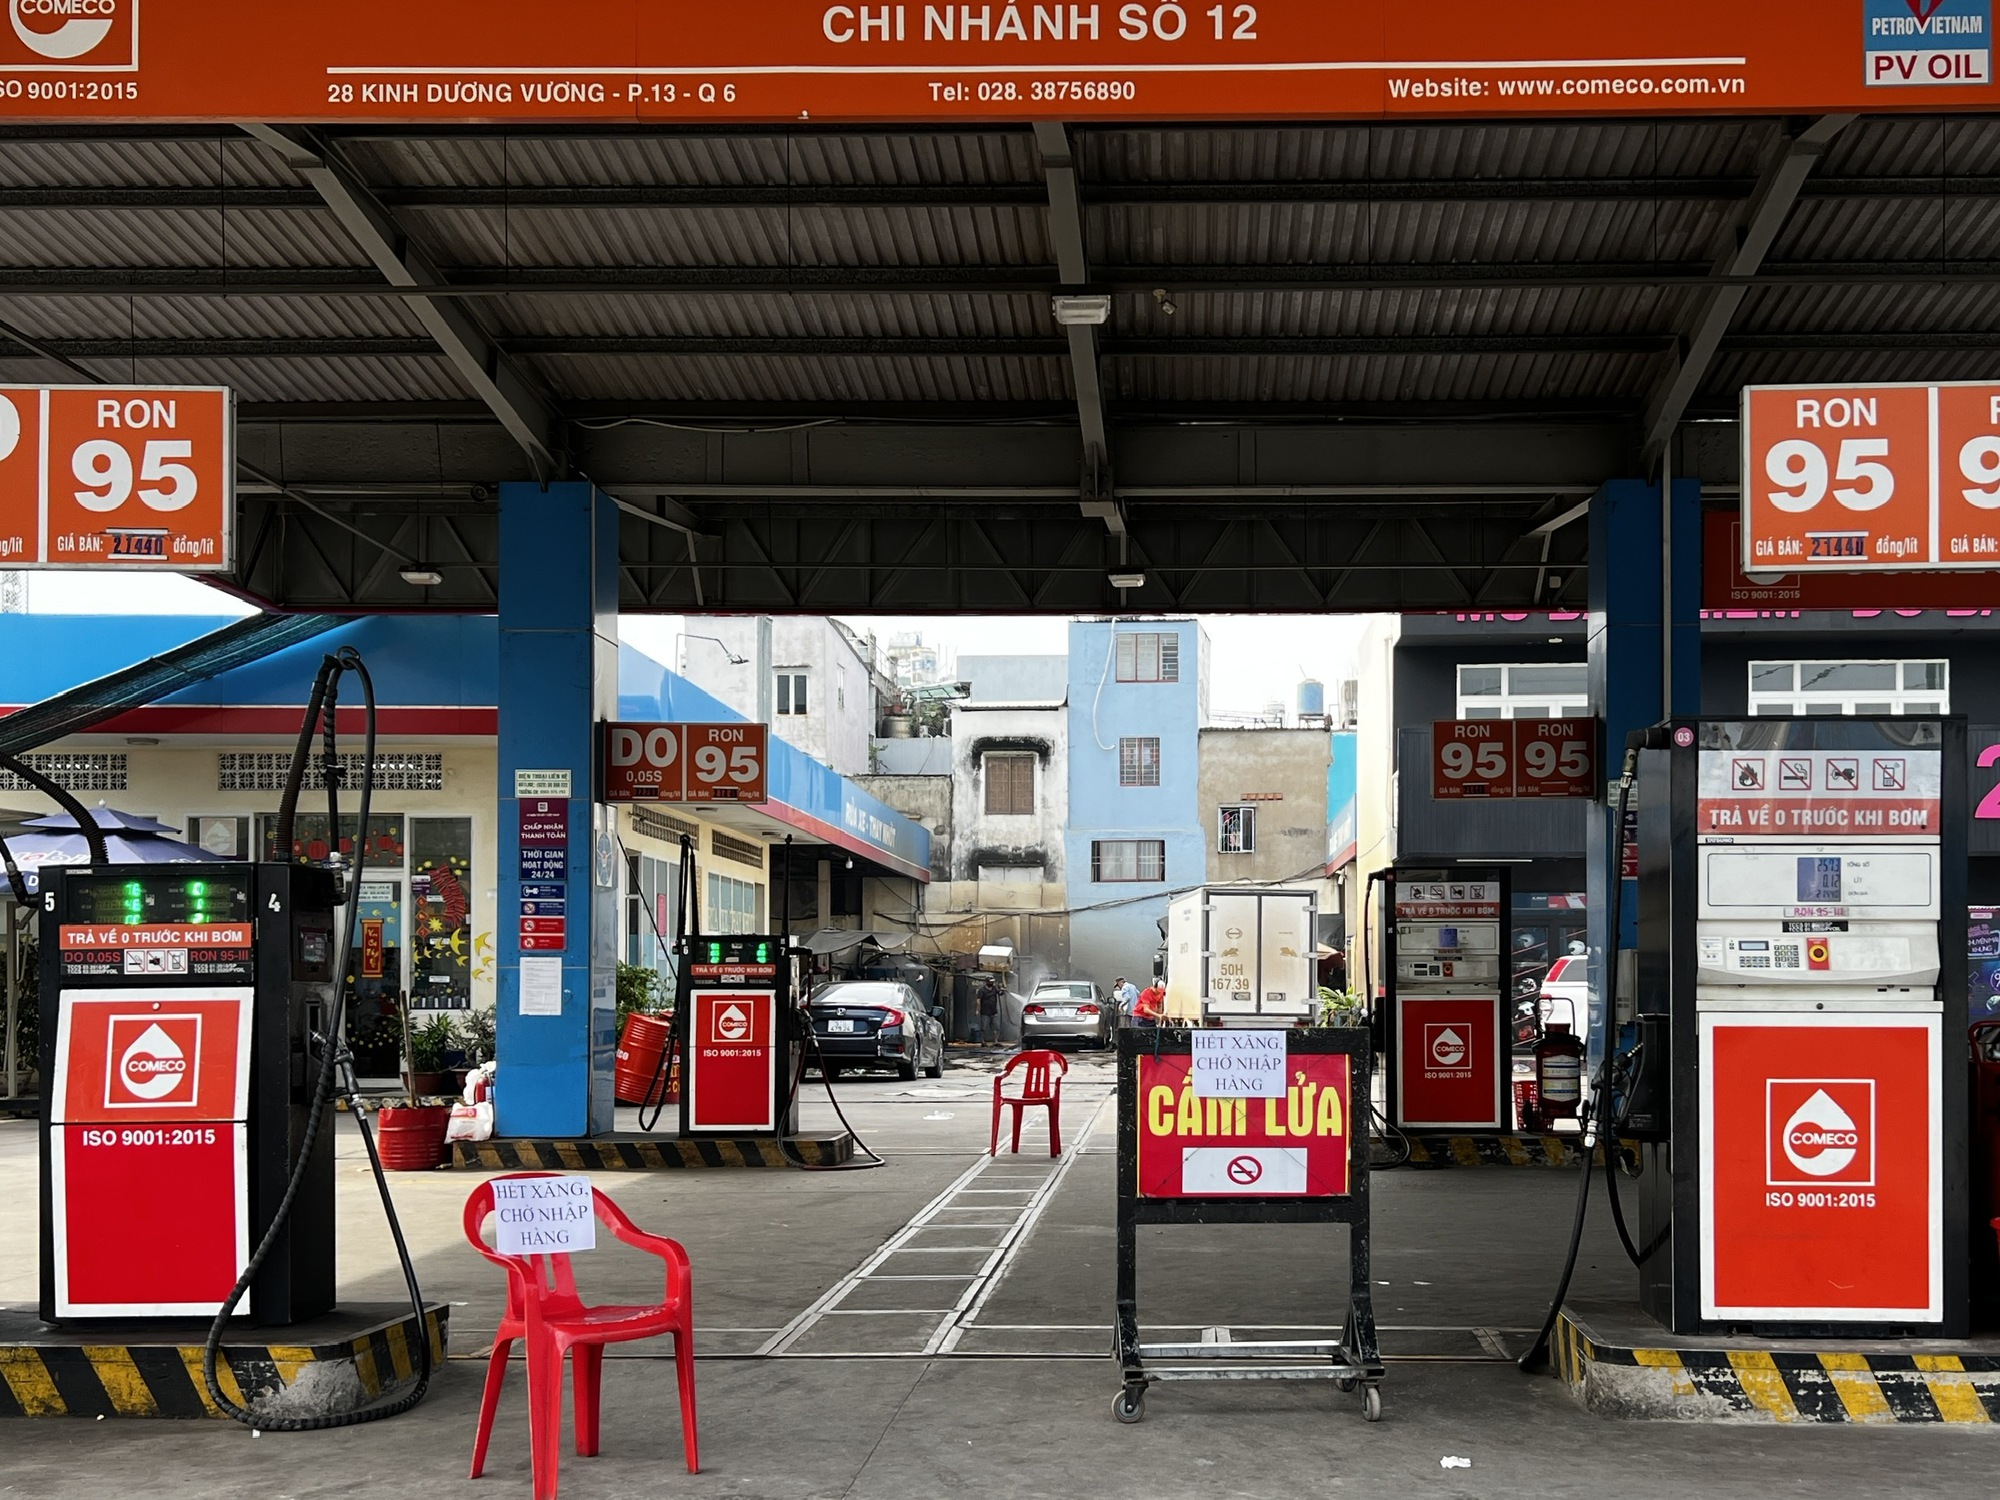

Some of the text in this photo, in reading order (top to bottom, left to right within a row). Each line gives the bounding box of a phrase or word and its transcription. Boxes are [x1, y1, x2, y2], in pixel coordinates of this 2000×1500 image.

[20, 0, 116, 14] COMECO
[822, 5, 905, 43] CHI
[924, 0, 1099, 41] NHÁNH
[1206, 4, 1258, 40] 12
[1871, 15, 1983, 36] PETROVIETNAM
[1874, 54, 1983, 80] PV OIL
[27, 81, 139, 100] 9001:2015
[327, 84, 354, 103] 28
[362, 83, 418, 103] KINH
[427, 81, 513, 103] DƯƠNG
[520, 81, 605, 103] VƯƠNG
[628, 83, 677, 103] P.13
[698, 83, 716, 103] Q
[723, 83, 736, 103] 6
[929, 81, 1136, 101] Tel: 028. 38756890
[1388, 76, 1746, 98] Website: www.comeco.com.vn
[97, 399, 176, 429] RON
[1796, 397, 1877, 428] RON
[72, 439, 198, 512] 95
[1765, 438, 1895, 512] 95
[57, 533, 214, 557] GIÁ BÁN: 21440 đồng/lít
[1755, 535, 1918, 557] GIÁ BÁN: 21440 đồng/lít
[1950, 534, 1998, 554] GIÁ BÁN:
[1731, 590, 1800, 600] ISO 9001:2015
[708, 729, 744, 742] RON
[1454, 725, 1490, 738] RON
[1538, 723, 1574, 737] RON
[1677, 731, 1691, 743] 03
[612, 728, 678, 768] DO
[695, 745, 760, 783] 95
[1441, 742, 1507, 779] 95
[1524, 741, 1590, 778] 95
[626, 770, 663, 783] 0,05S
[1709, 803, 1928, 826] TRẢ VỀ 0 TRƯỚC KHI BƠM
[522, 849, 564, 859] THỜI GIAN
[522, 859, 564, 870] HOẠT ĐỘNG
[531, 870, 555, 879] 24/24
[45, 891, 55, 912] 5
[267, 892, 281, 912] 4
[67, 928, 243, 944] TRẢ VỀ 0 TRƯỚC KHI BƠM
[64, 952, 121, 965] DO 0,05S
[190, 950, 249, 961] RON 95-III
[683, 945, 689, 955] 6
[780, 946, 786, 956] 7
[1220, 963, 1244, 976] 50H
[1211, 978, 1250, 990] 167.39
[1194, 1032, 1284, 1052] HẾT XĂNG,
[719, 1049, 762, 1057] 9001:2015
[128, 1060, 186, 1072] COMECO
[1196, 1053, 1282, 1075] CHỜ NHẬP
[1215, 1076, 1263, 1092] HÀNG
[1424, 1071, 1472, 1079] ISO 9001:2015
[1265, 1070, 1343, 1137] LỬA
[82, 1129, 216, 1147] ISO 9001:2015
[1790, 1132, 1858, 1146] COMECO
[495, 1181, 589, 1199] HẾT XĂNG,
[1766, 1192, 1876, 1208] ISO 9001:2015
[500, 1201, 588, 1223] CHỜ NHẬP
[520, 1227, 570, 1246] HÀNG
